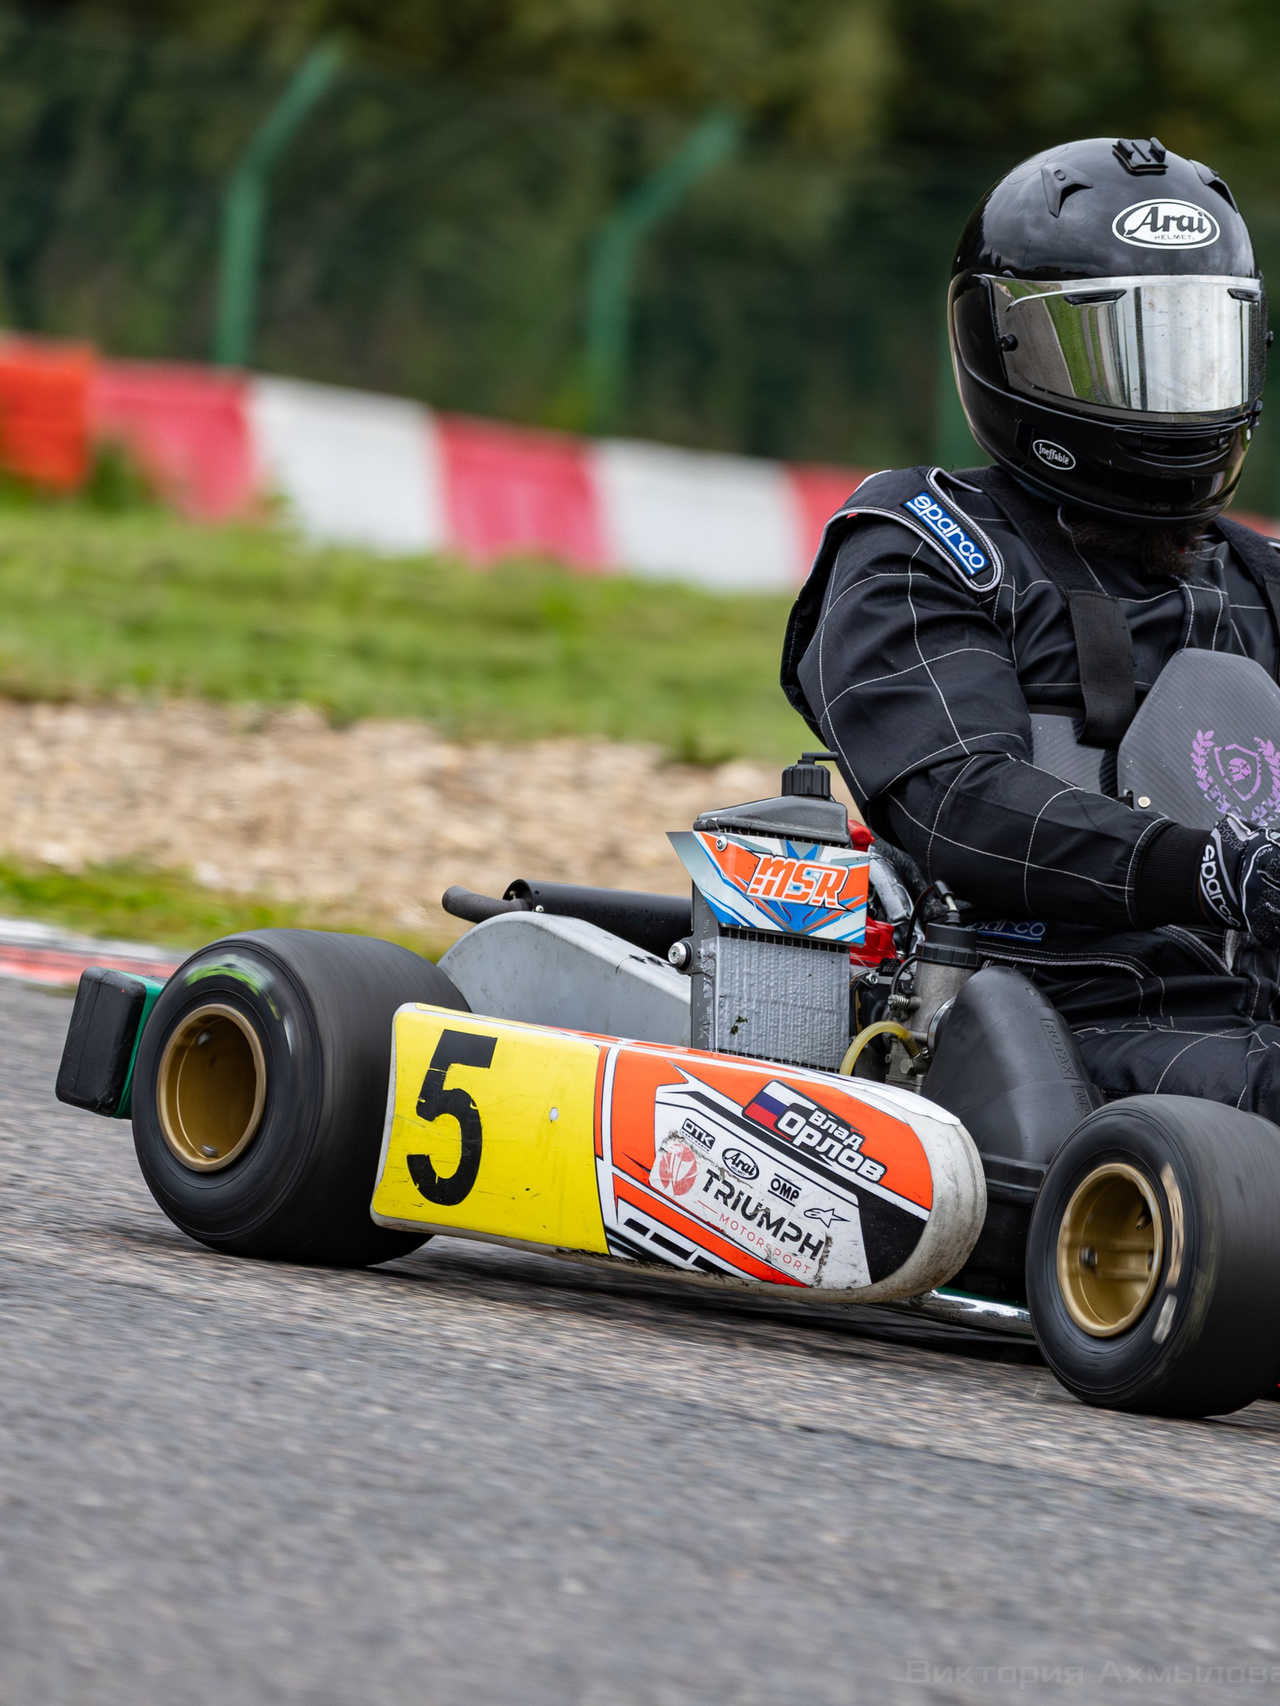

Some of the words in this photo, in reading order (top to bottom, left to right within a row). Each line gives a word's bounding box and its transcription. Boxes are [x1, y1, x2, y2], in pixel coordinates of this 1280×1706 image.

[1125, 206, 1207, 235] Arai
[913, 495, 985, 569] sparco
[748, 856, 847, 908] MSR
[1200, 844, 1241, 927] sparco
[966, 919, 1046, 937] parco
[406, 1028, 499, 1207] 5
[683, 1120, 715, 1148] OTK
[723, 1152, 756, 1176] Arai
[702, 1168, 824, 1261] TRIUMPH
[769, 1179, 801, 1202] OMP
[718, 1212, 811, 1275] MOTORSPORT
